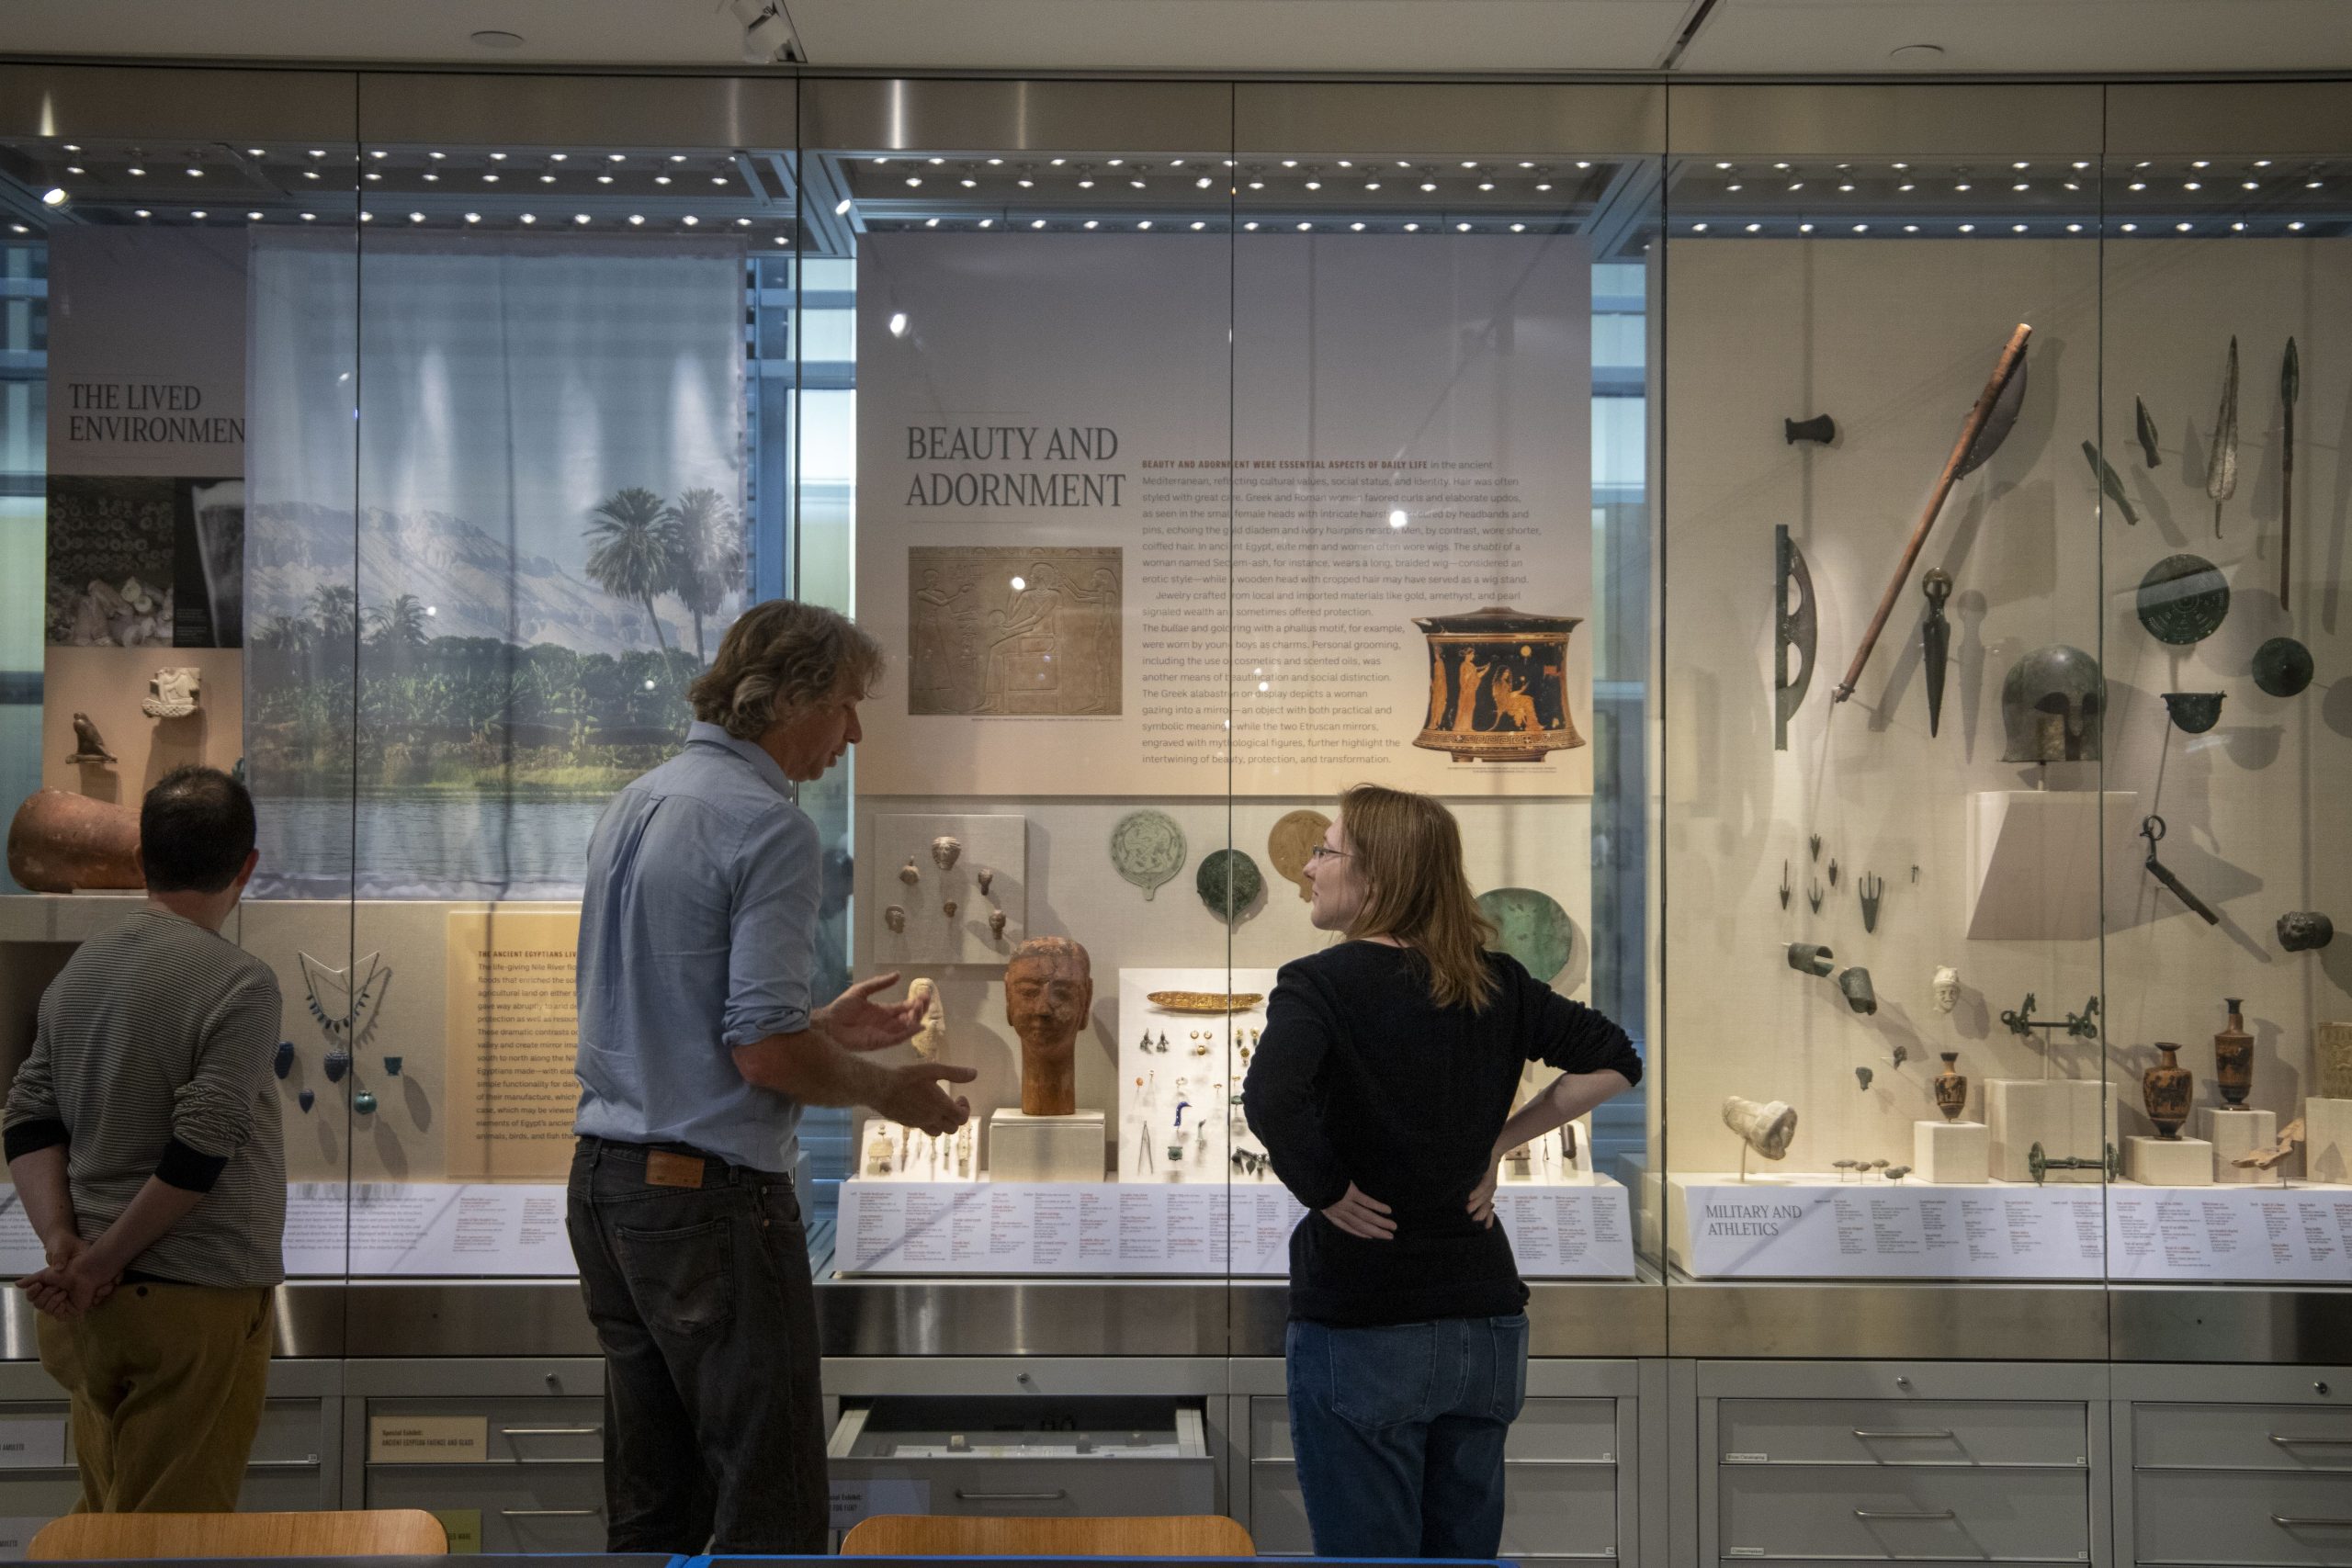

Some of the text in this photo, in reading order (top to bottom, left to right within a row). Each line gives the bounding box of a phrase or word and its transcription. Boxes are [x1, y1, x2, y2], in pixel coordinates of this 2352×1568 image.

[69, 384, 201, 411] THE LIVED
[69, 416, 245, 443] ENVIRONMEN
[907, 426, 1118, 460] BEAUTY AND
[1142, 460, 1175, 468] BEAUTY
[1179, 460, 1194, 468] AND
[1254, 460, 1276, 468] WERE
[1280, 460, 1325, 468] ESSENTIAL
[1329, 460, 1365, 468] ASPECTS
[1369, 460, 1378, 468] OF
[1382, 460, 1406, 468] DAILY
[1409, 460, 1427, 468] LIFE
[1459, 460, 1492, 469] ancient
[1142, 477, 1518, 488] Mediterranean, cultural values, social status, Hair often
[905, 472, 1126, 506] ADORNMENT
[1142, 492, 1170, 504] styled
[1173, 492, 1192, 502] with
[1195, 493, 1218, 504] great
[1246, 492, 1272, 502] Greek
[1295, 492, 1326, 502] Roman
[1365, 493, 1398, 502] favored
[1401, 493, 1423, 502] curls
[1445, 493, 1487, 502] elaborate
[1235, 509, 1265, 519] female
[1268, 509, 1295, 519] heads
[1460, 509, 1509, 519] headbands
[1142, 525, 1542, 537] pins, echoing diadem ivory hairpins contrast, shorter,
[1246, 541, 1273, 553] Egypt,
[1454, 542, 1470, 551] The
[1142, 558, 1430, 570] woman named instance, long, braided
[1142, 573, 1529, 586] erotic wooden cropped hair may have served wig stand.
[1156, 590, 1191, 602] Jewelry
[1193, 590, 1226, 600] crafted
[1252, 590, 1273, 600] local
[1297, 591, 1338, 603] imported
[1341, 591, 1383, 600] materials
[1386, 591, 1403, 600] like
[1406, 591, 1427, 603] gold,
[1498, 591, 1520, 603] pearl
[1142, 606, 1373, 619] signaled wealth sometimes offered protection.
[1233, 623, 1251, 635] ring
[1284, 623, 1317, 635] phallus
[1364, 623, 1405, 635] example,
[1273, 639, 1309, 649] charms.
[1313, 639, 1351, 649] Personal
[1354, 639, 1400, 651] grooming,
[1142, 655, 1339, 668] including cosmetics scented
[1142, 671, 1177, 682] another
[1311, 672, 1337, 682] social
[1340, 672, 1391, 682] distinction.
[1161, 688, 1187, 698] Greek
[1256, 688, 1286, 700] display
[1290, 688, 1323, 701] depicts
[1143, 705, 1373, 717] gazing into object both practical
[1143, 721, 1378, 733] symbolic Etruscan mirrors,
[1143, 738, 1383, 750] engraved figures, further highlight
[1143, 754, 1391, 766] intertwining protection, transformation.
[1705, 1204, 1803, 1219] MILITARY AND
[1708, 1223, 1779, 1235] ATHLETICS
